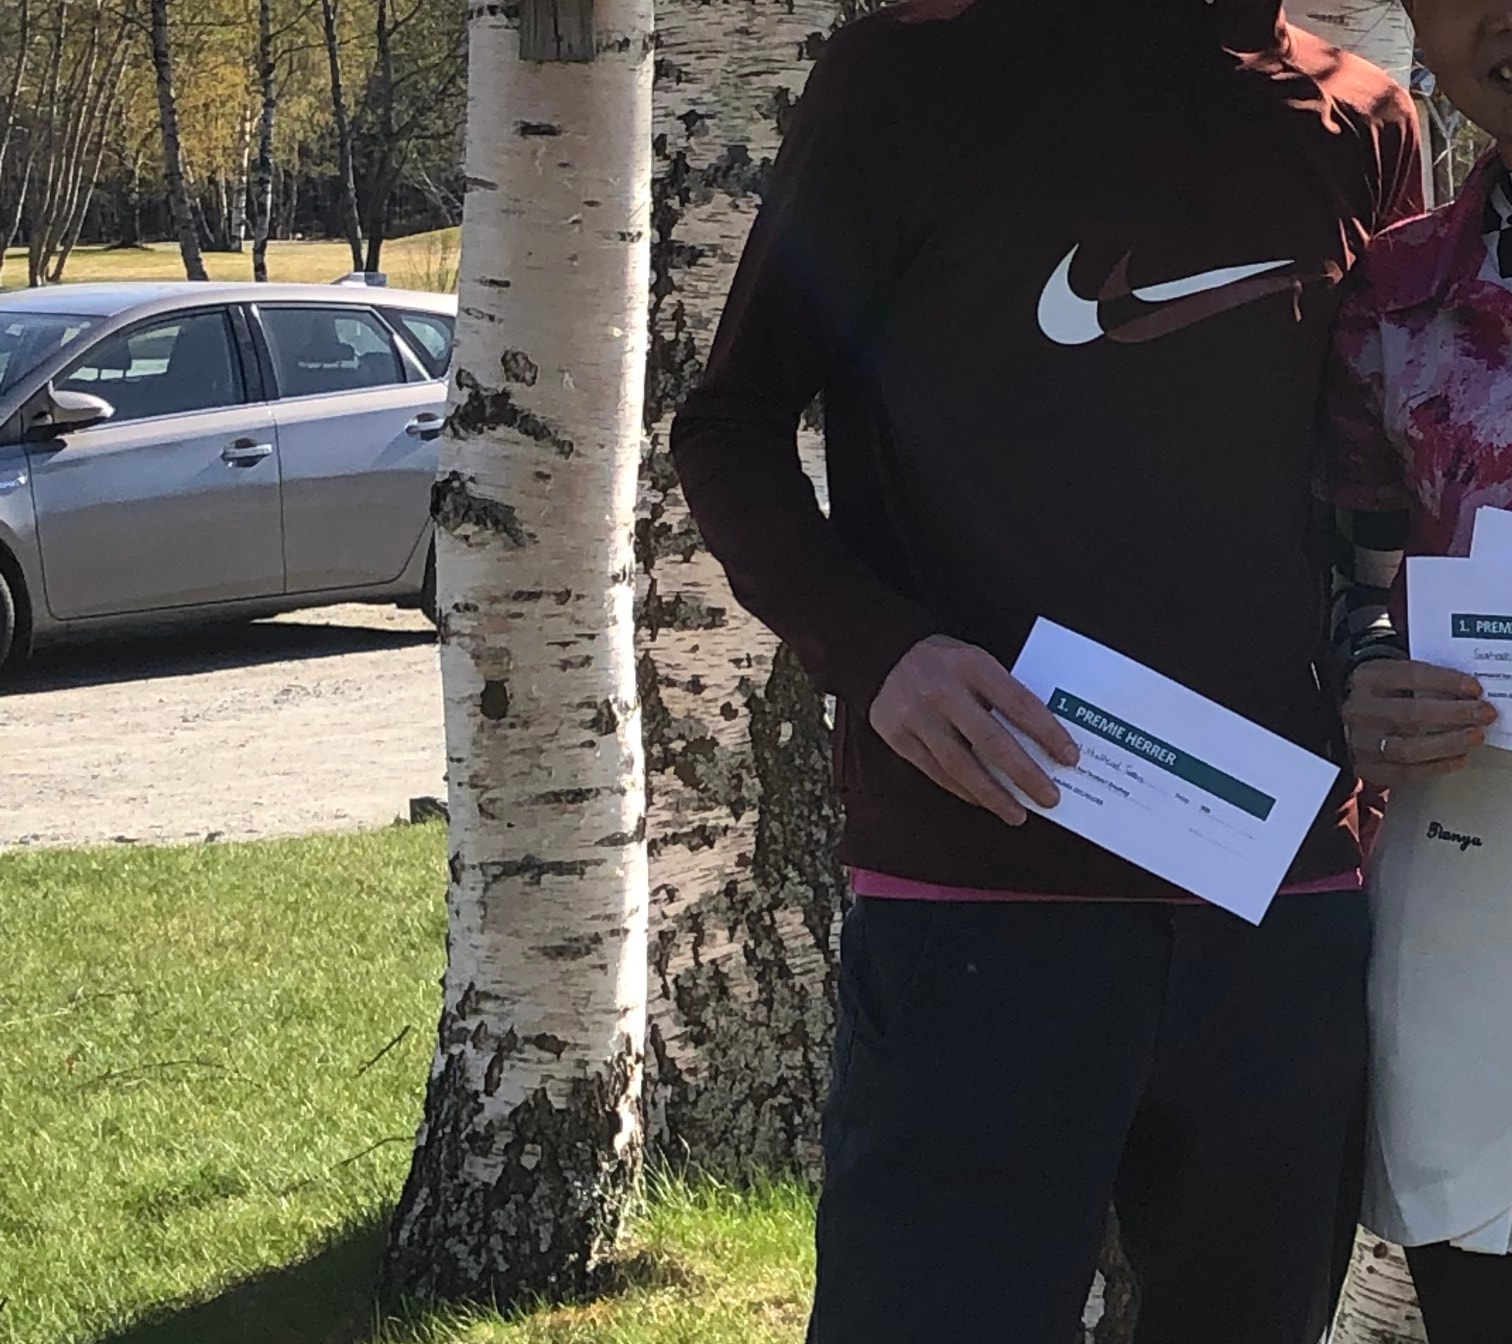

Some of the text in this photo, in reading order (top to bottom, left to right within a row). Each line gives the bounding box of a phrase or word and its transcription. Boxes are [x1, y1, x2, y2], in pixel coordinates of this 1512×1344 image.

[1459, 620, 1471, 631] 1.
[1056, 698, 1071, 713] 1.
[1074, 707, 1125, 740] PREMIE
[1125, 732, 1177, 766] HERRER
